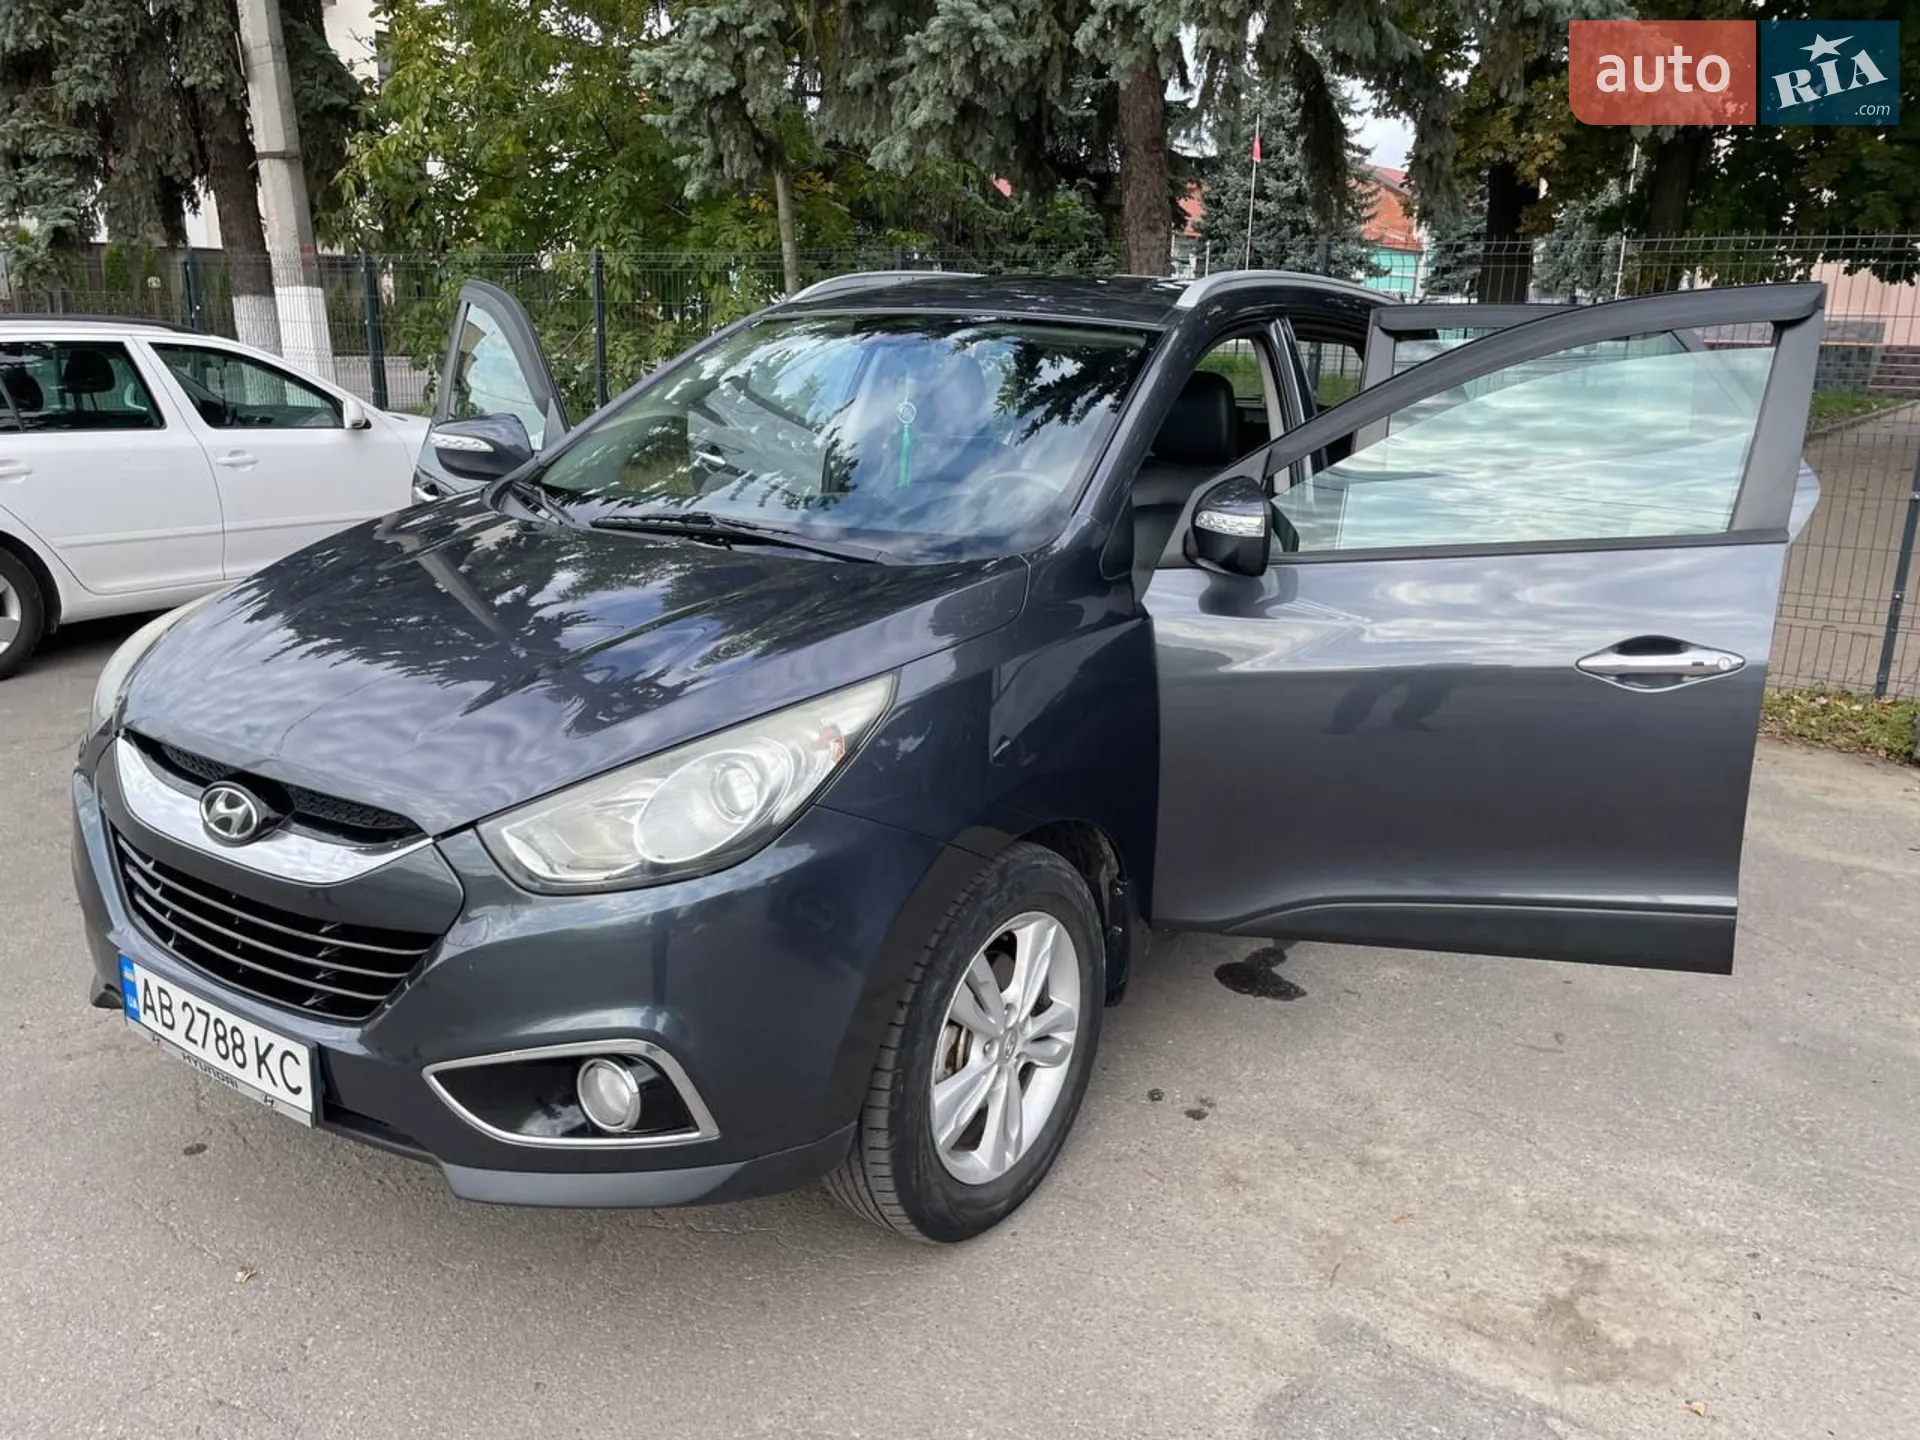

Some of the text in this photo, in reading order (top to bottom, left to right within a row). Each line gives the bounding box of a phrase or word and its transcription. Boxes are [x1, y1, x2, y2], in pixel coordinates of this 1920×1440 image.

[143, 978, 303, 1096] AB 2788 KC
